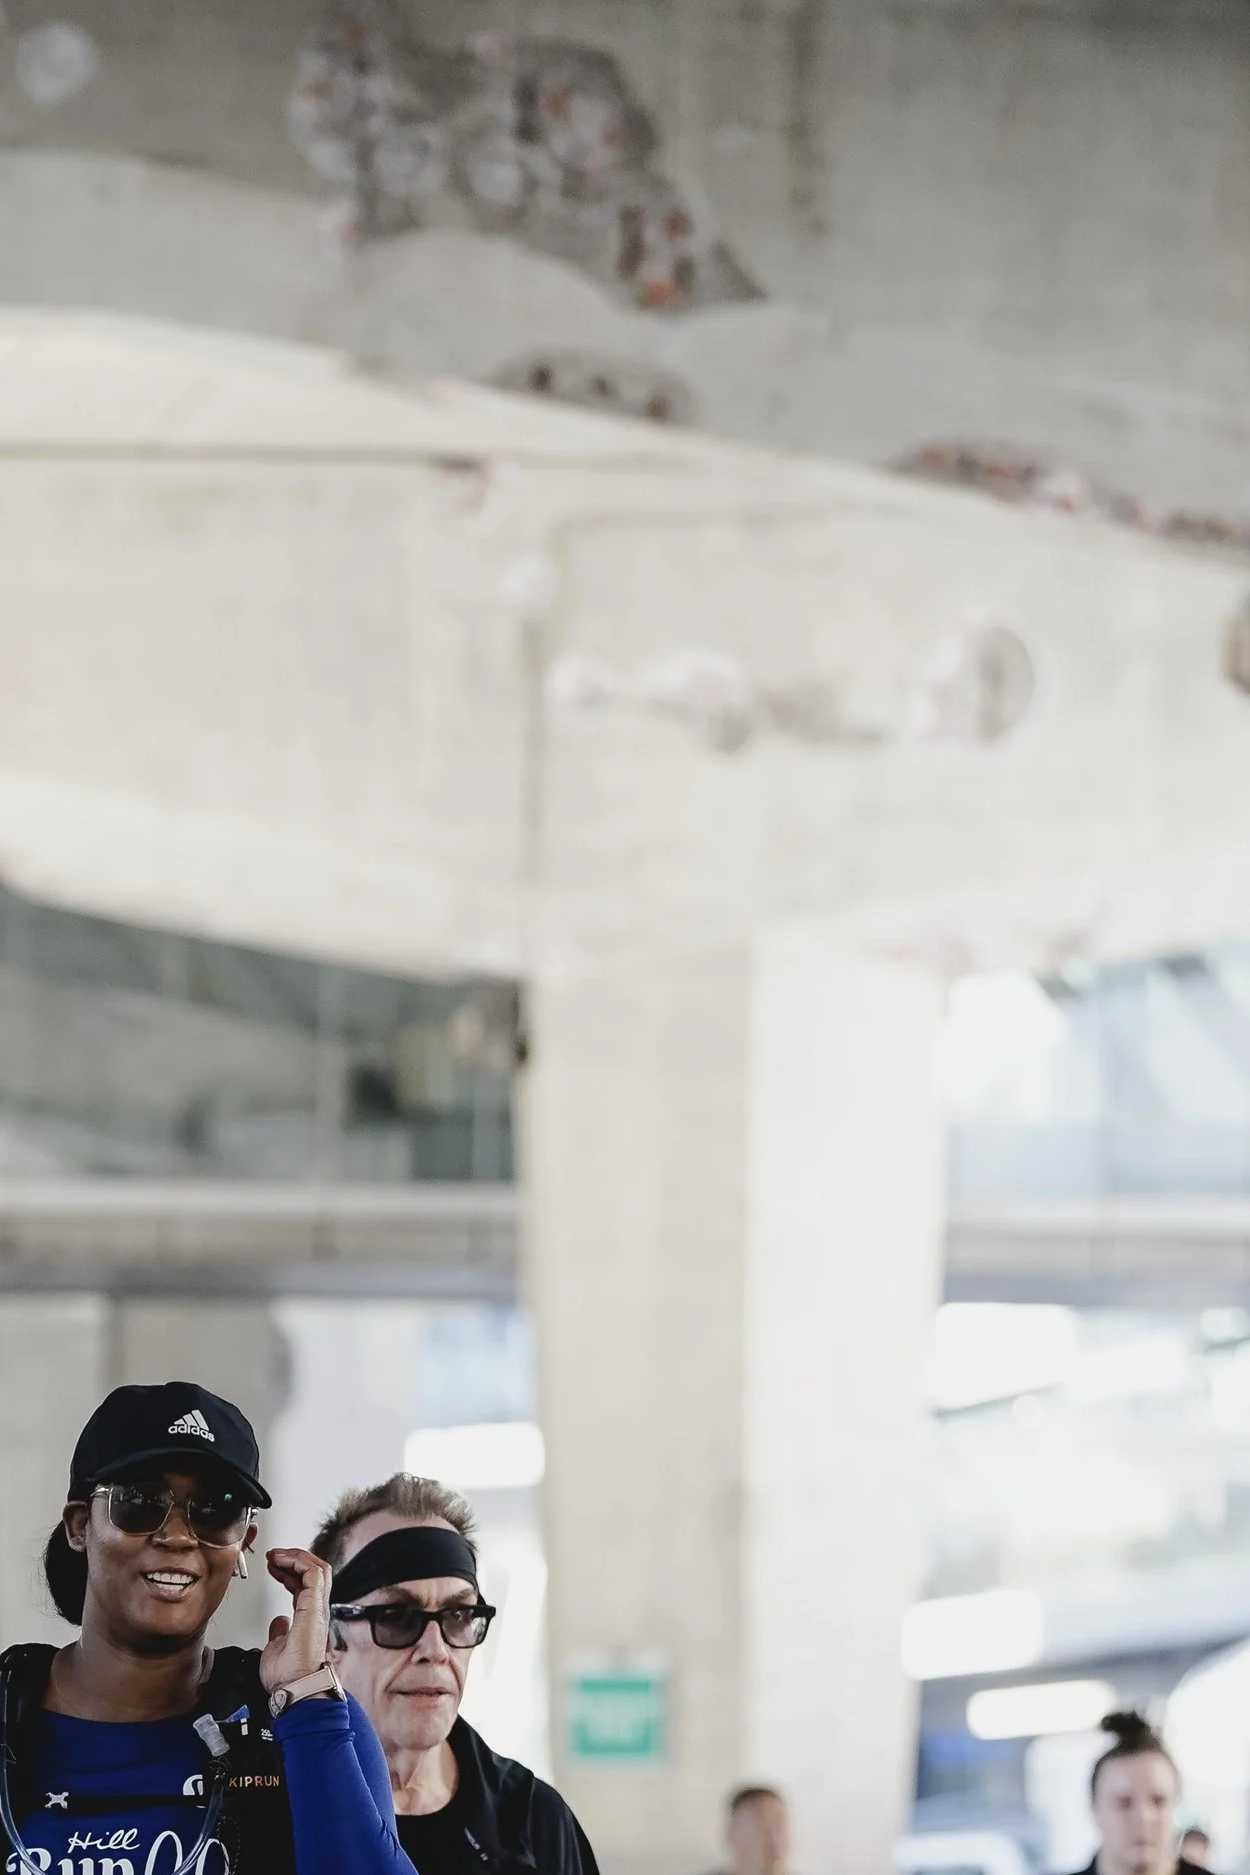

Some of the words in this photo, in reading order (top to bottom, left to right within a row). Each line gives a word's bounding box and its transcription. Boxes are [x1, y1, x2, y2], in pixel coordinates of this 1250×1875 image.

[168, 1422, 215, 1442] adidas
[229, 1775, 280, 1787] KIPRUN
[68, 1828, 141, 1854] Hill
